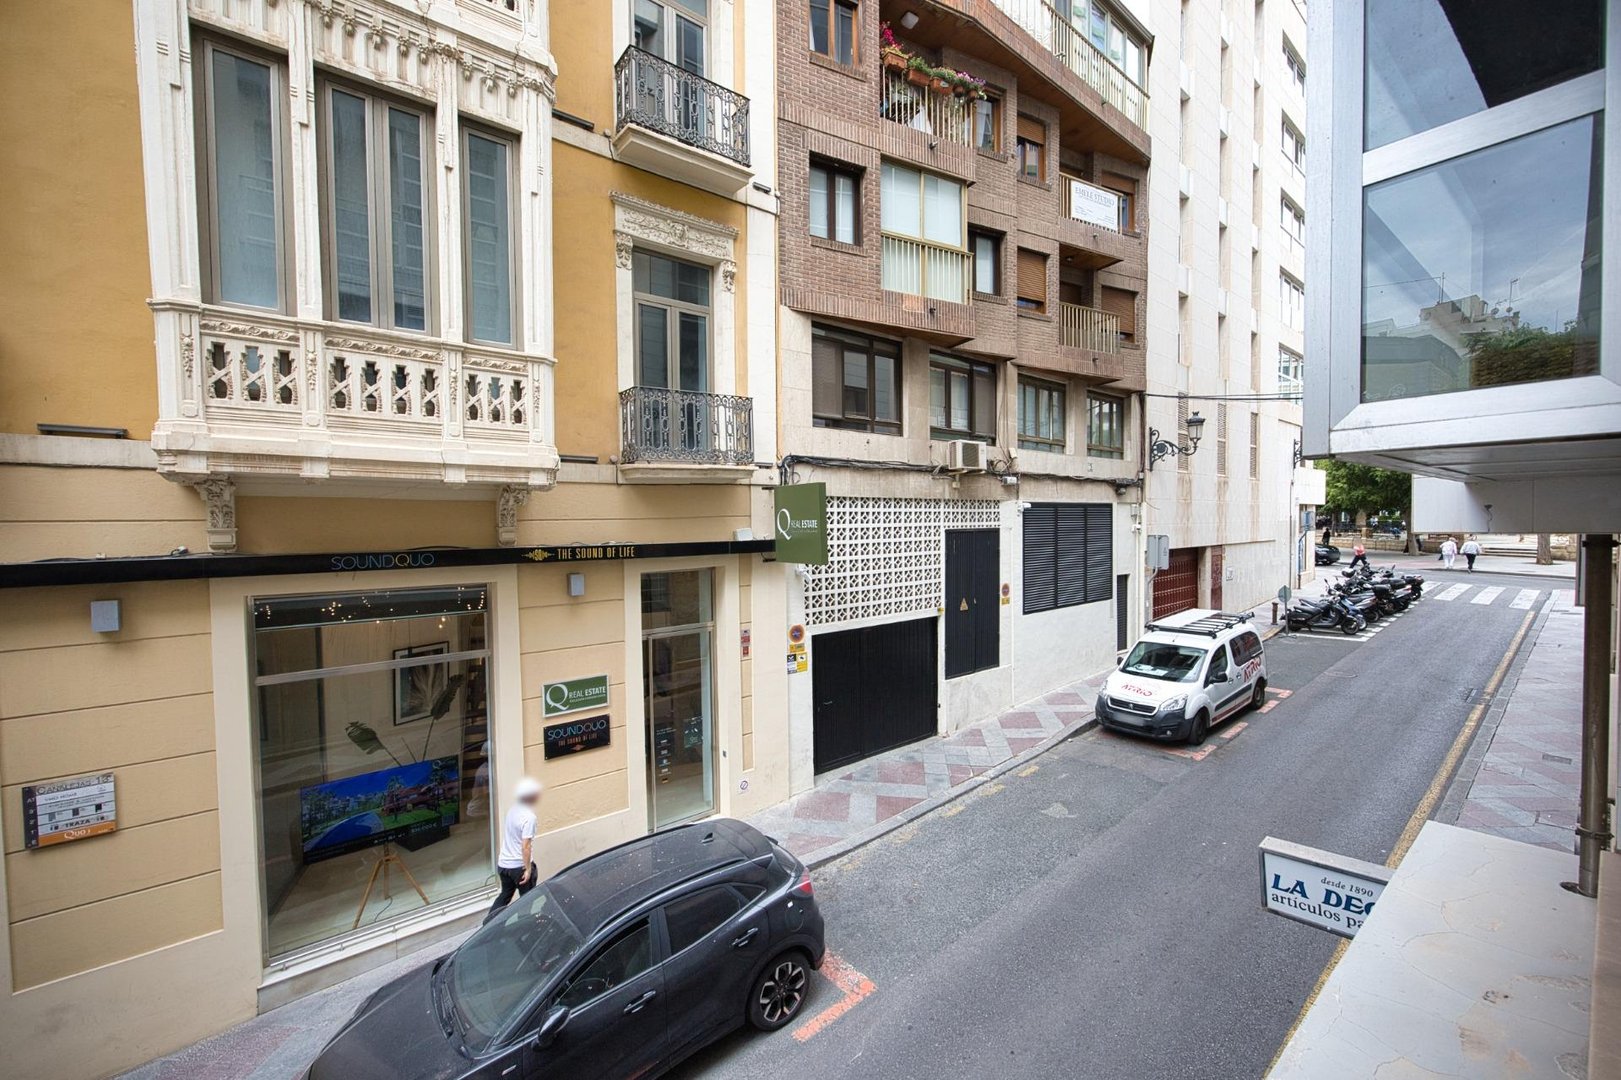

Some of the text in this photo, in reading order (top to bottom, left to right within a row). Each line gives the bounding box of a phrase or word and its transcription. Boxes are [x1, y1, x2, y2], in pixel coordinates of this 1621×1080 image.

[777, 508, 818, 540] Q REAL ESTATE
[331, 553, 434, 570] SOUNDQUO
[557, 546, 635, 559] THE SOUND OF LIFE
[546, 683, 569, 711] Q
[568, 691, 584, 699] REAL
[584, 686, 606, 697] ESTATE
[547, 719, 607, 741] SOUNDQUO
[1271, 873, 1309, 899] LA
[1321, 877, 1374, 898] desde 1890
[1271, 893, 1341, 922] artículos
